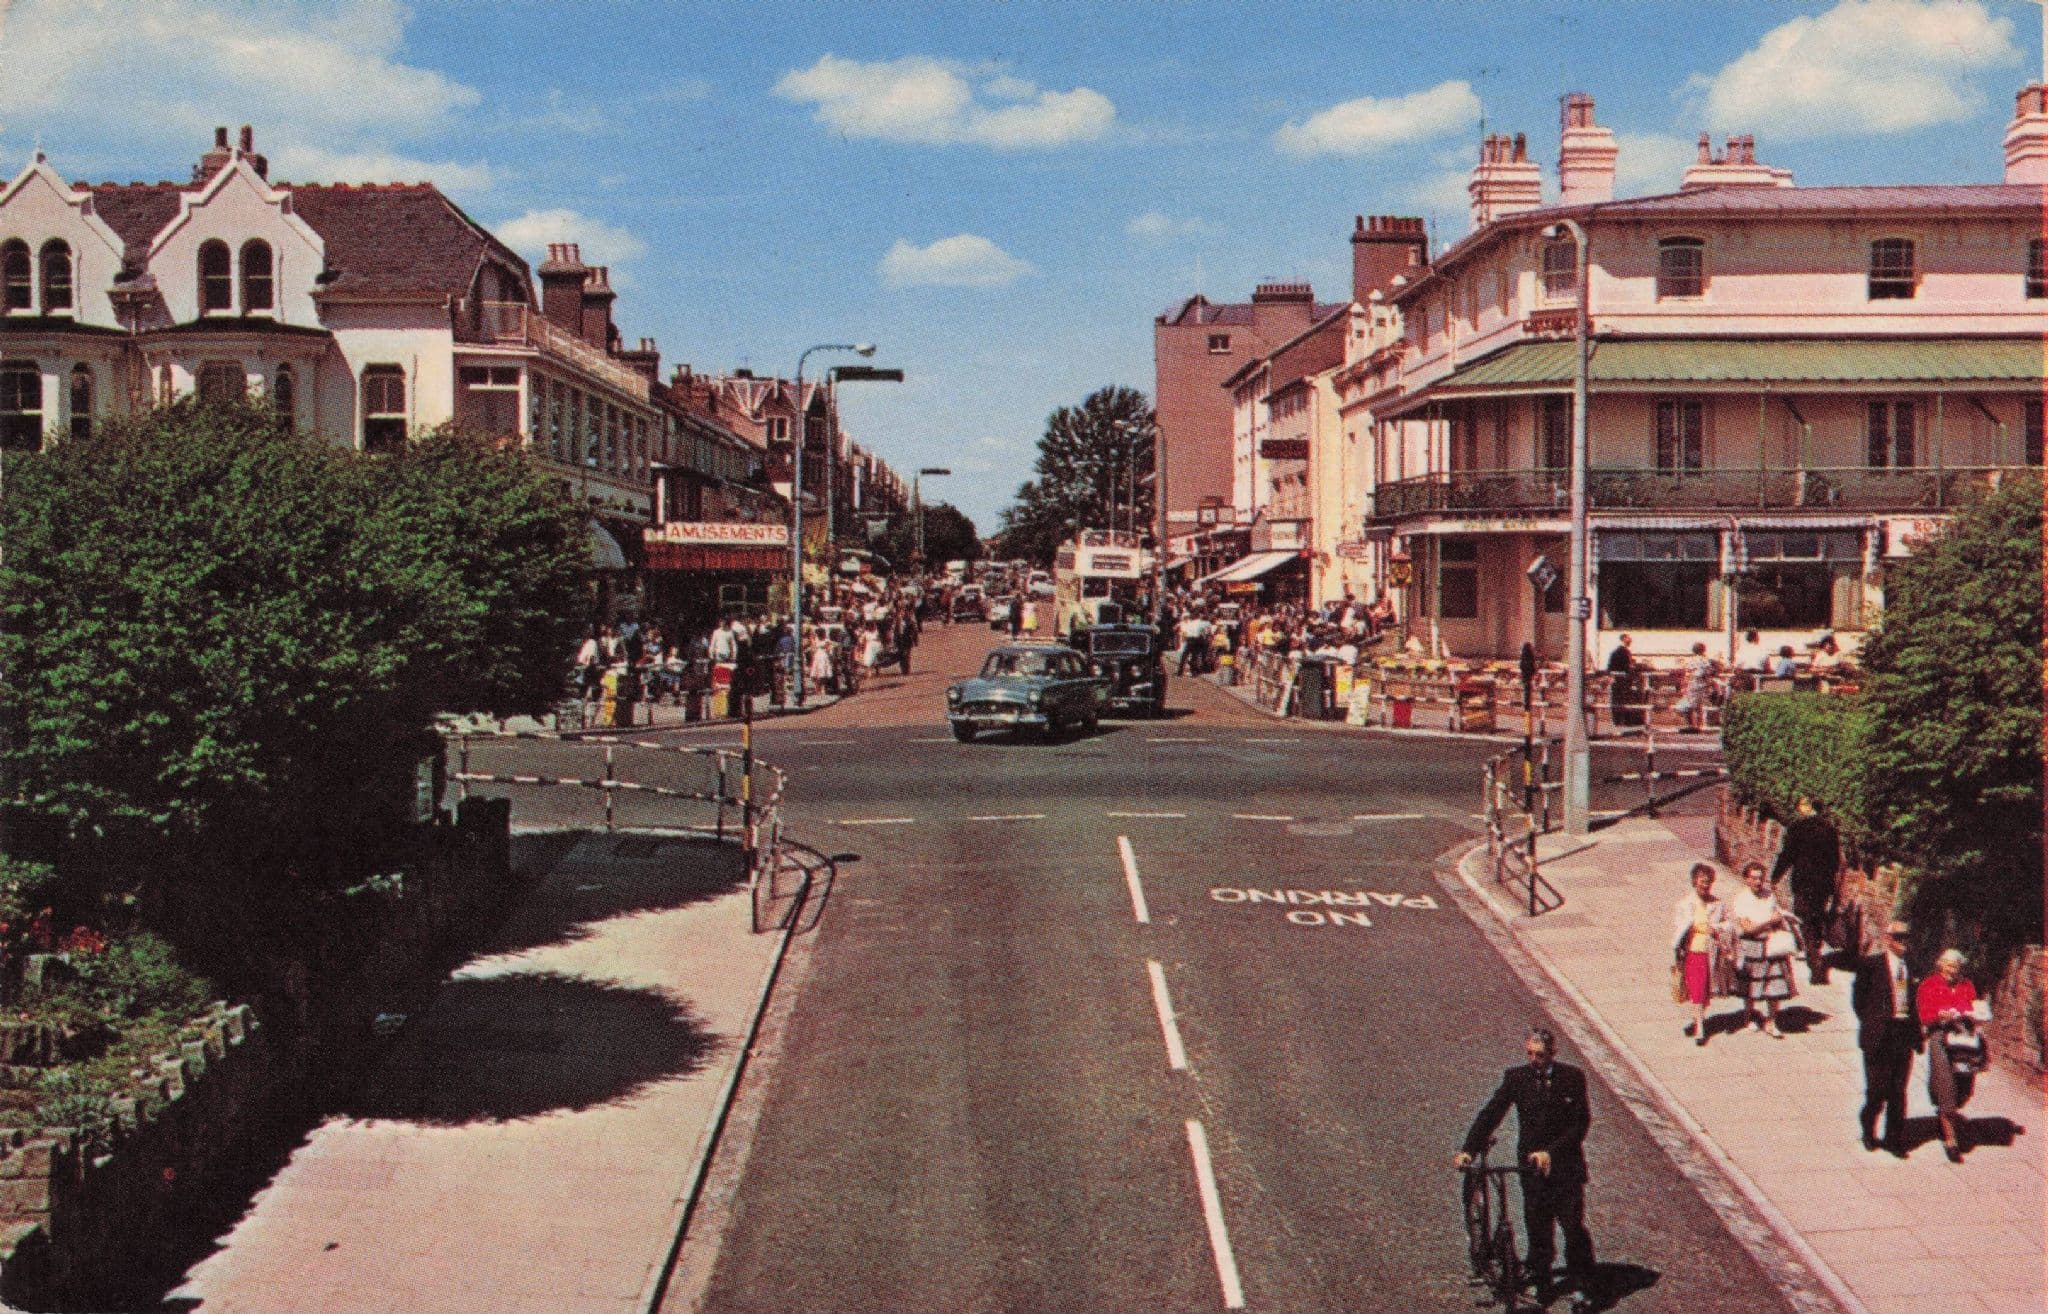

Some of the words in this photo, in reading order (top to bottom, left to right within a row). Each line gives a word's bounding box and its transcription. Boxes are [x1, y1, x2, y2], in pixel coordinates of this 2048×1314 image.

[670, 525, 786, 539] AMUSEMENTS
[1210, 887, 1439, 910] PARKING
[1286, 910, 1372, 928] NO
